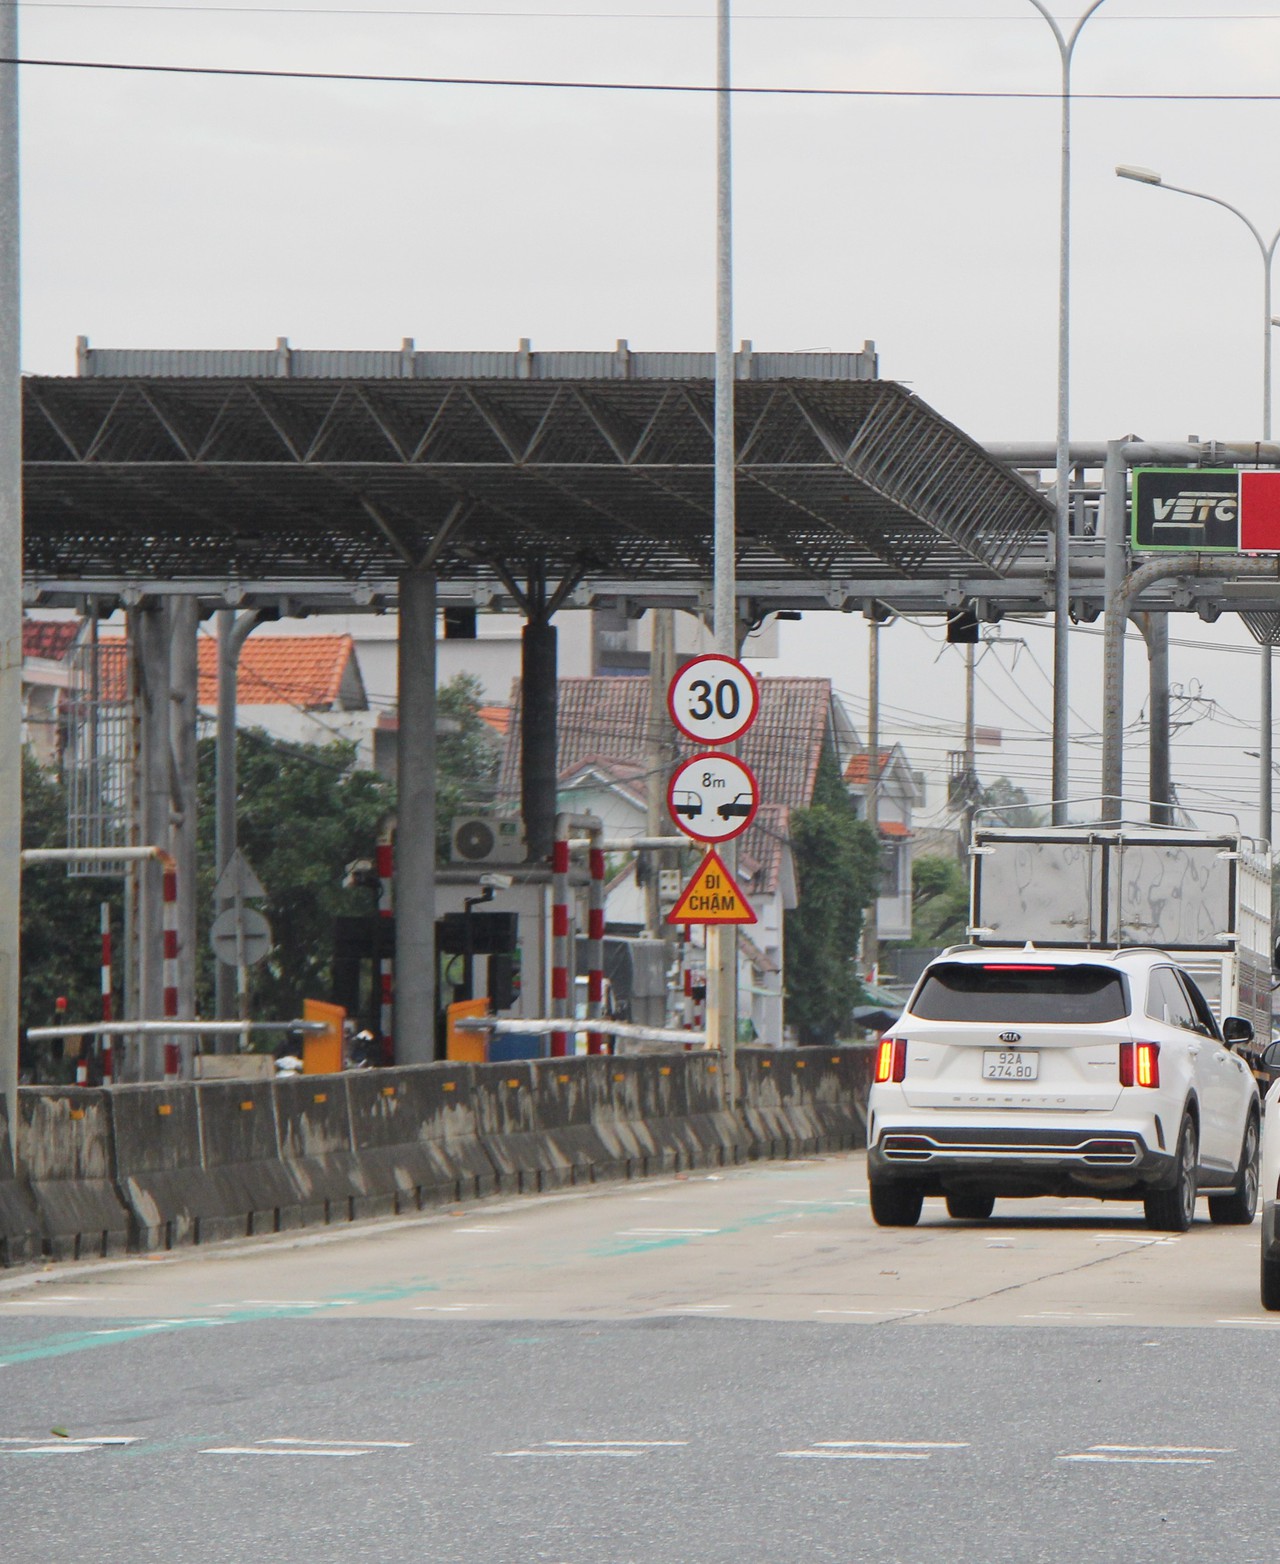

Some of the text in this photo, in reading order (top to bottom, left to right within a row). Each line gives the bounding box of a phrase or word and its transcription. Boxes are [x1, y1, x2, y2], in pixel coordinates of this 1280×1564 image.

[1152, 497, 1238, 522] VETC
[688, 679, 740, 720] 30
[702, 772, 726, 788] 8m
[705, 874, 720, 889] ĐI
[688, 893, 735, 914] CHẬM
[1002, 1032, 1019, 1042] KIA
[999, 1053, 1022, 1065] 92A
[988, 1066, 1032, 1078] 274.80
